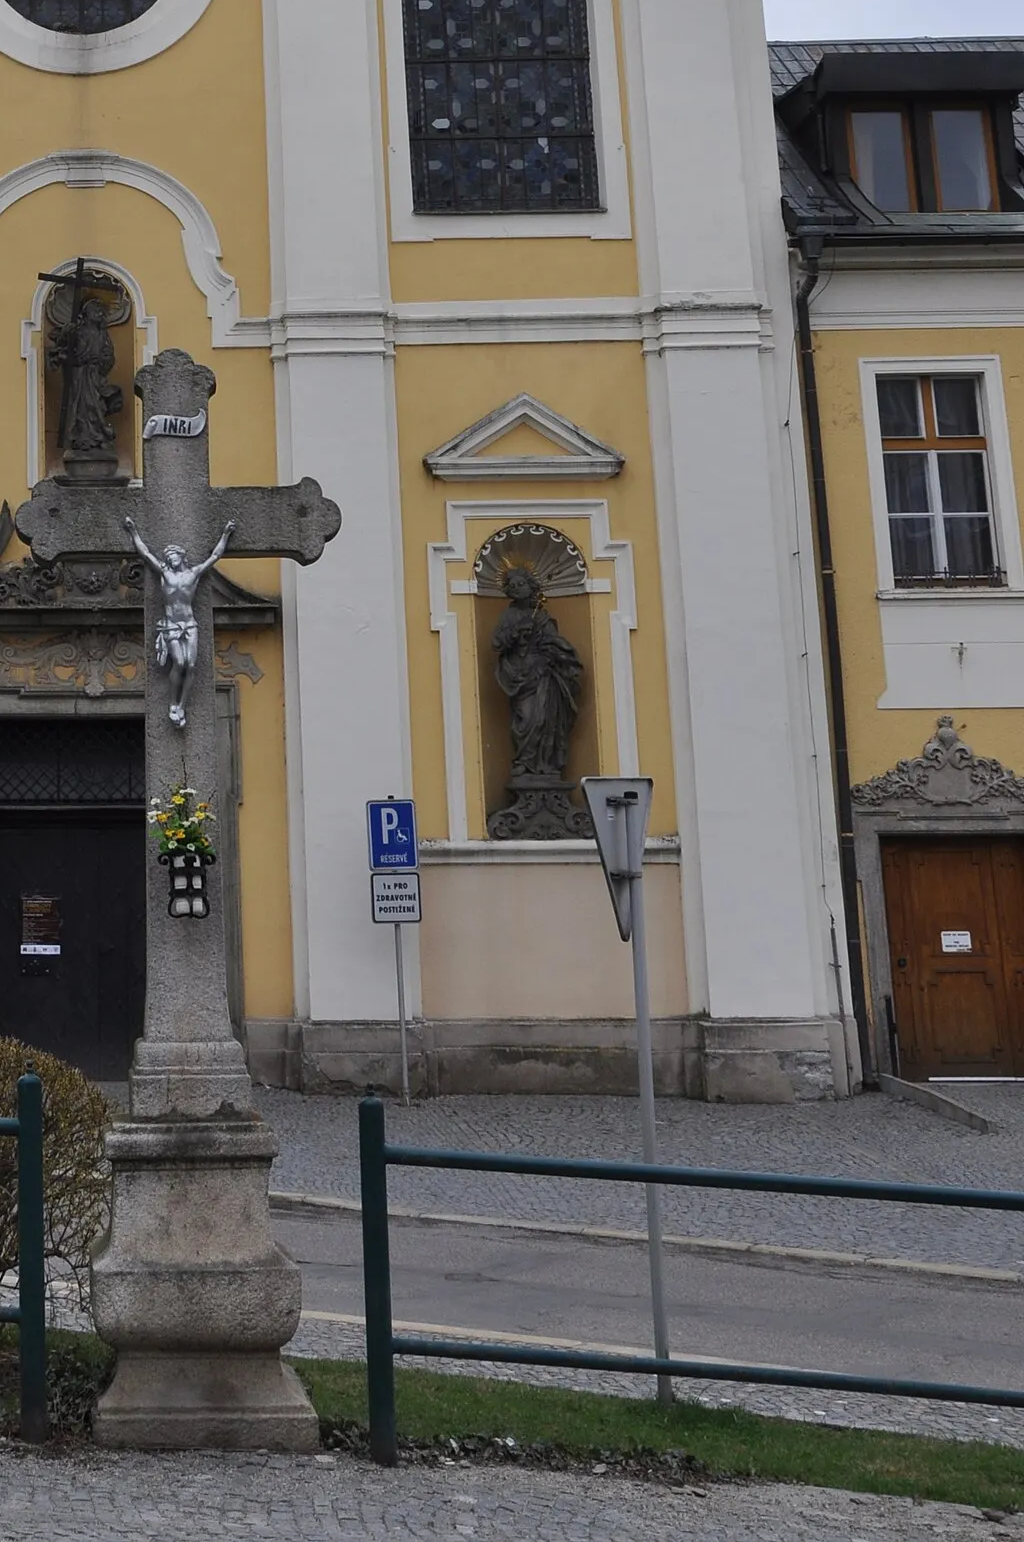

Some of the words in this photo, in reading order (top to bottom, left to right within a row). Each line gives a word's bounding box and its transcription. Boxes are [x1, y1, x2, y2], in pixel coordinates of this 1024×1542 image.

[163, 417, 191, 434] INRI
[381, 808, 398, 844] P
[383, 882, 391, 890] 1x
[393, 882, 408, 890] PRO
